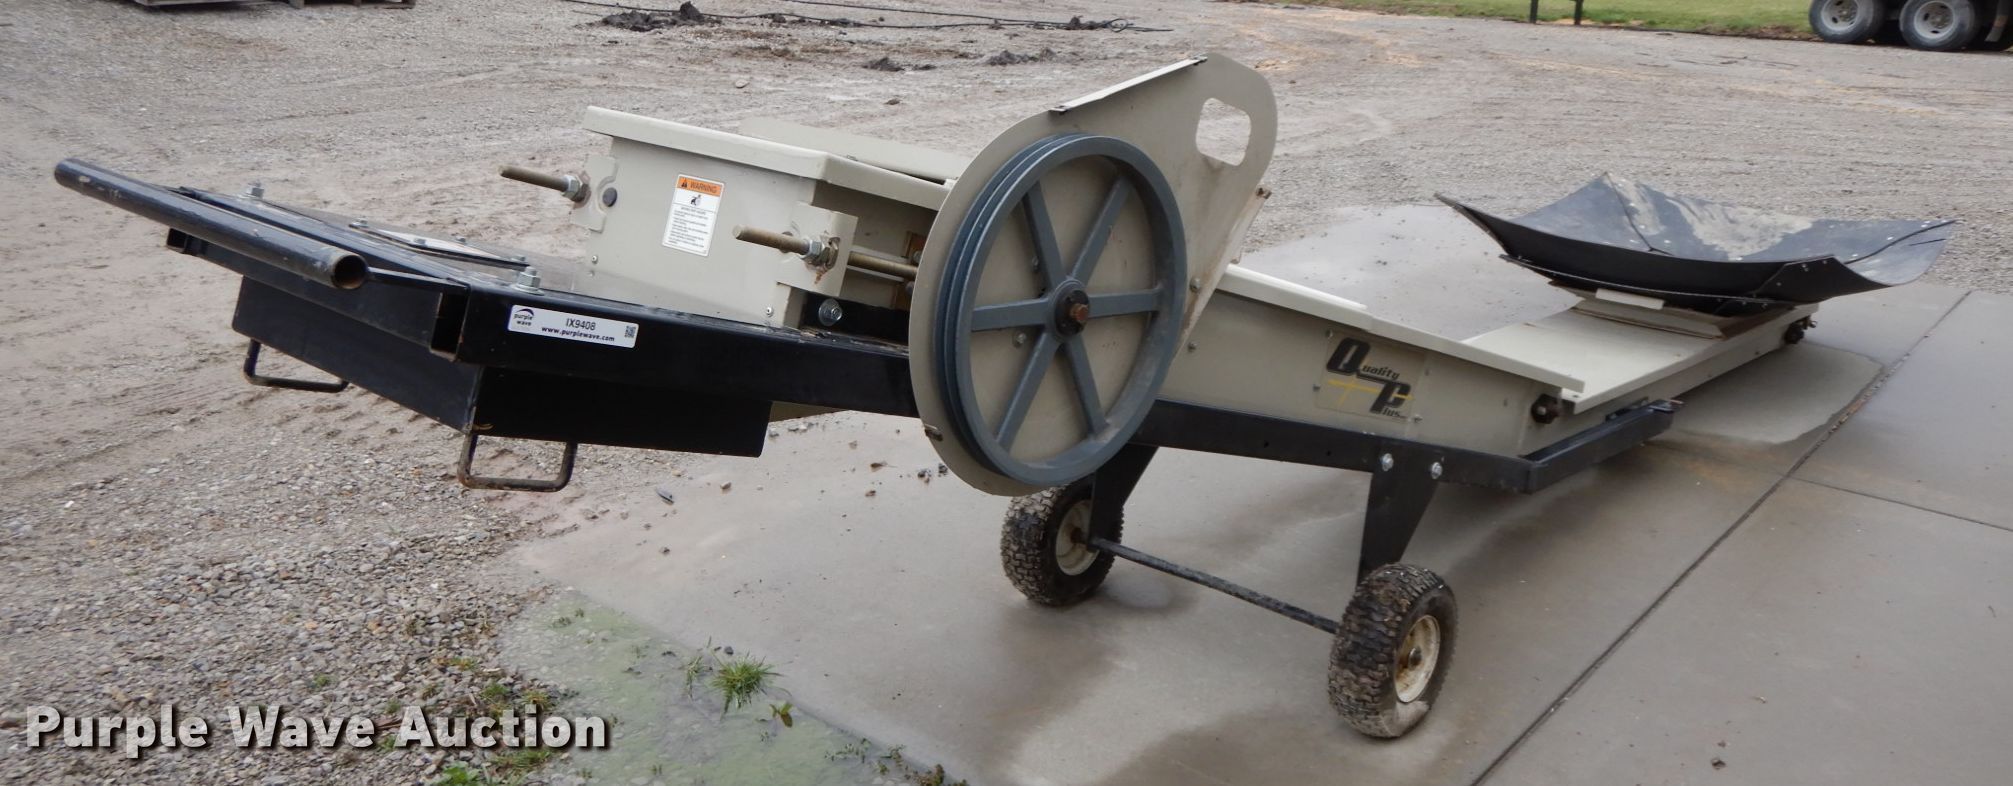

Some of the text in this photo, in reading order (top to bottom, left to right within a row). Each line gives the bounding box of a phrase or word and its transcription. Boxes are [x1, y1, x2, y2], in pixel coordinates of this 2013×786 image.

[690, 181, 717, 193] WARNING
[514, 313, 533, 321] purple
[566, 318, 596, 331] IX9408
[541, 326, 615, 342] www.purplewave.com
[1326, 337, 1400, 380] Quality
